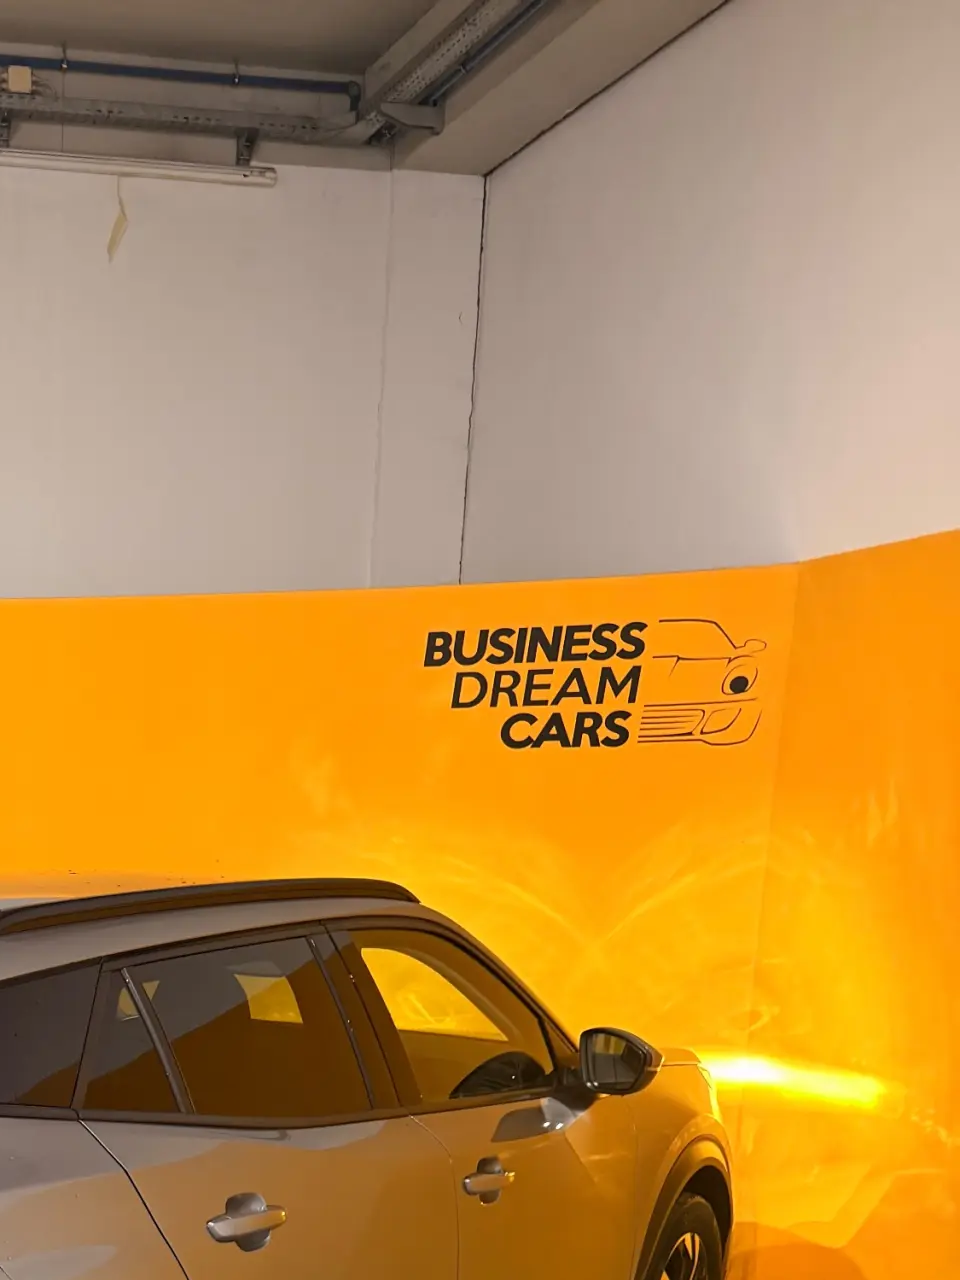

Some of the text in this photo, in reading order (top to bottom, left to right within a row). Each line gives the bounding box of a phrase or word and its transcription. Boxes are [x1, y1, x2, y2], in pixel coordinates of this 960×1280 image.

[424, 622, 648, 667] BUSINESS
[451, 665, 642, 709] DREAM
[500, 710, 632, 749] CARS
